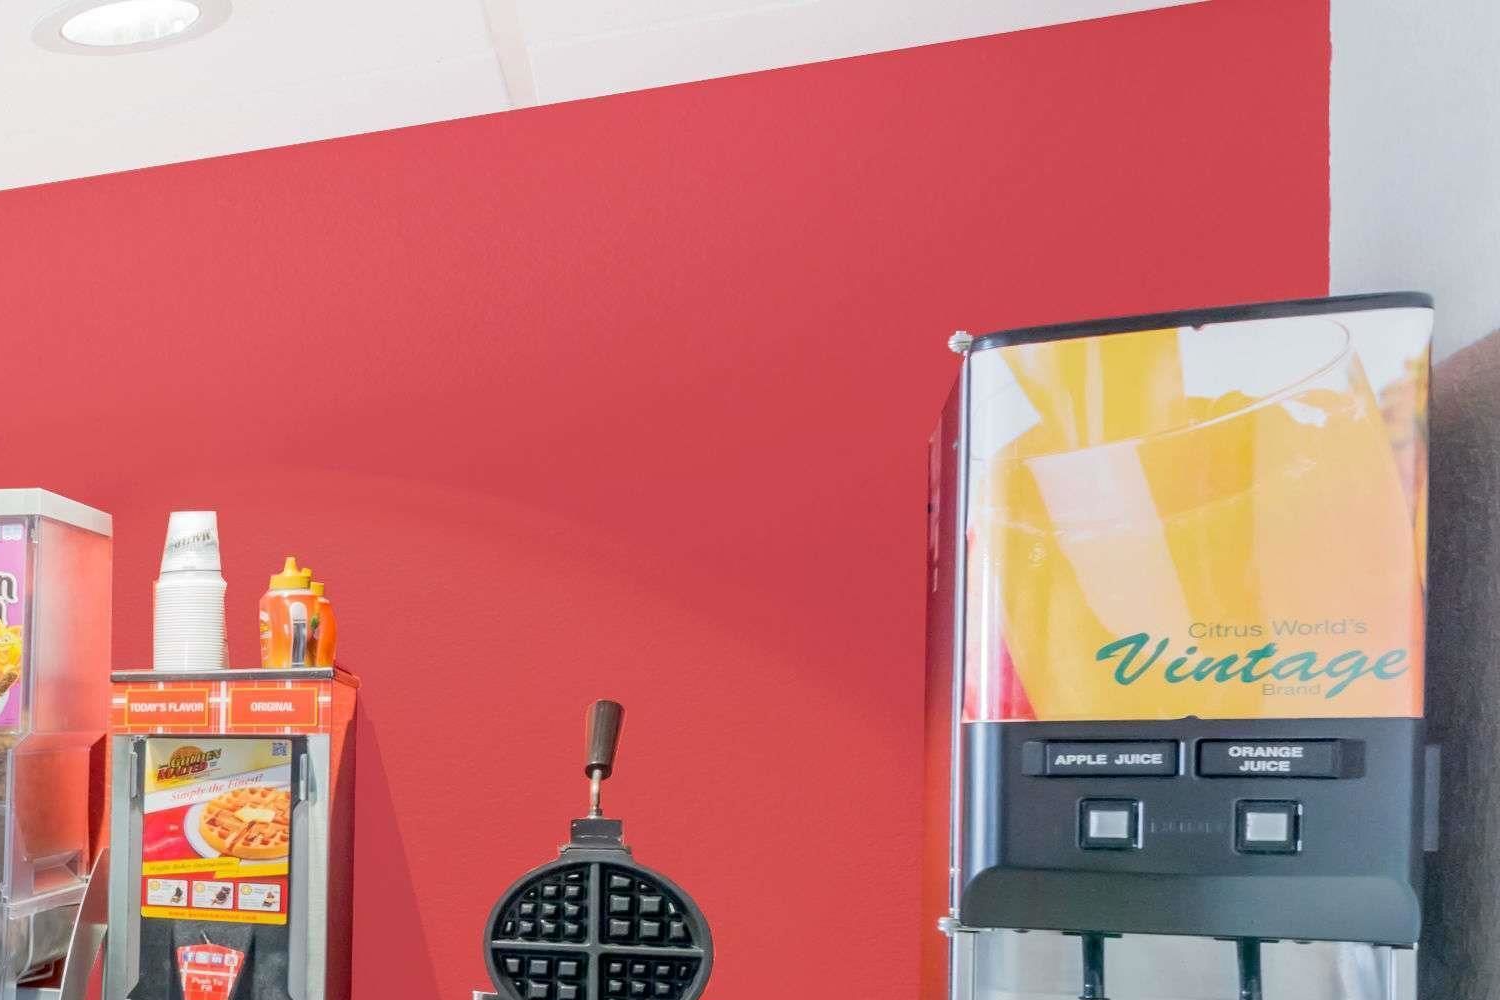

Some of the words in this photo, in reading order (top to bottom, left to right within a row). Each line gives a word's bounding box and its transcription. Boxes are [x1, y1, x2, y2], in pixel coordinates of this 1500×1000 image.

[1188, 622, 1263, 639] Citrus
[1271, 619, 1368, 637] World's
[1095, 632, 1411, 699] Vintage
[1261, 683, 1322, 697] Brand
[130, 702, 167, 712] TODAY'S
[168, 702, 205, 712] FLAVOR
[250, 702, 294, 712] ORIGINAL
[1228, 746, 1304, 758] ORANGE
[1054, 754, 1108, 766] APPLE
[1114, 753, 1163, 765] JUICE
[1239, 761, 1291, 772] JUICE
